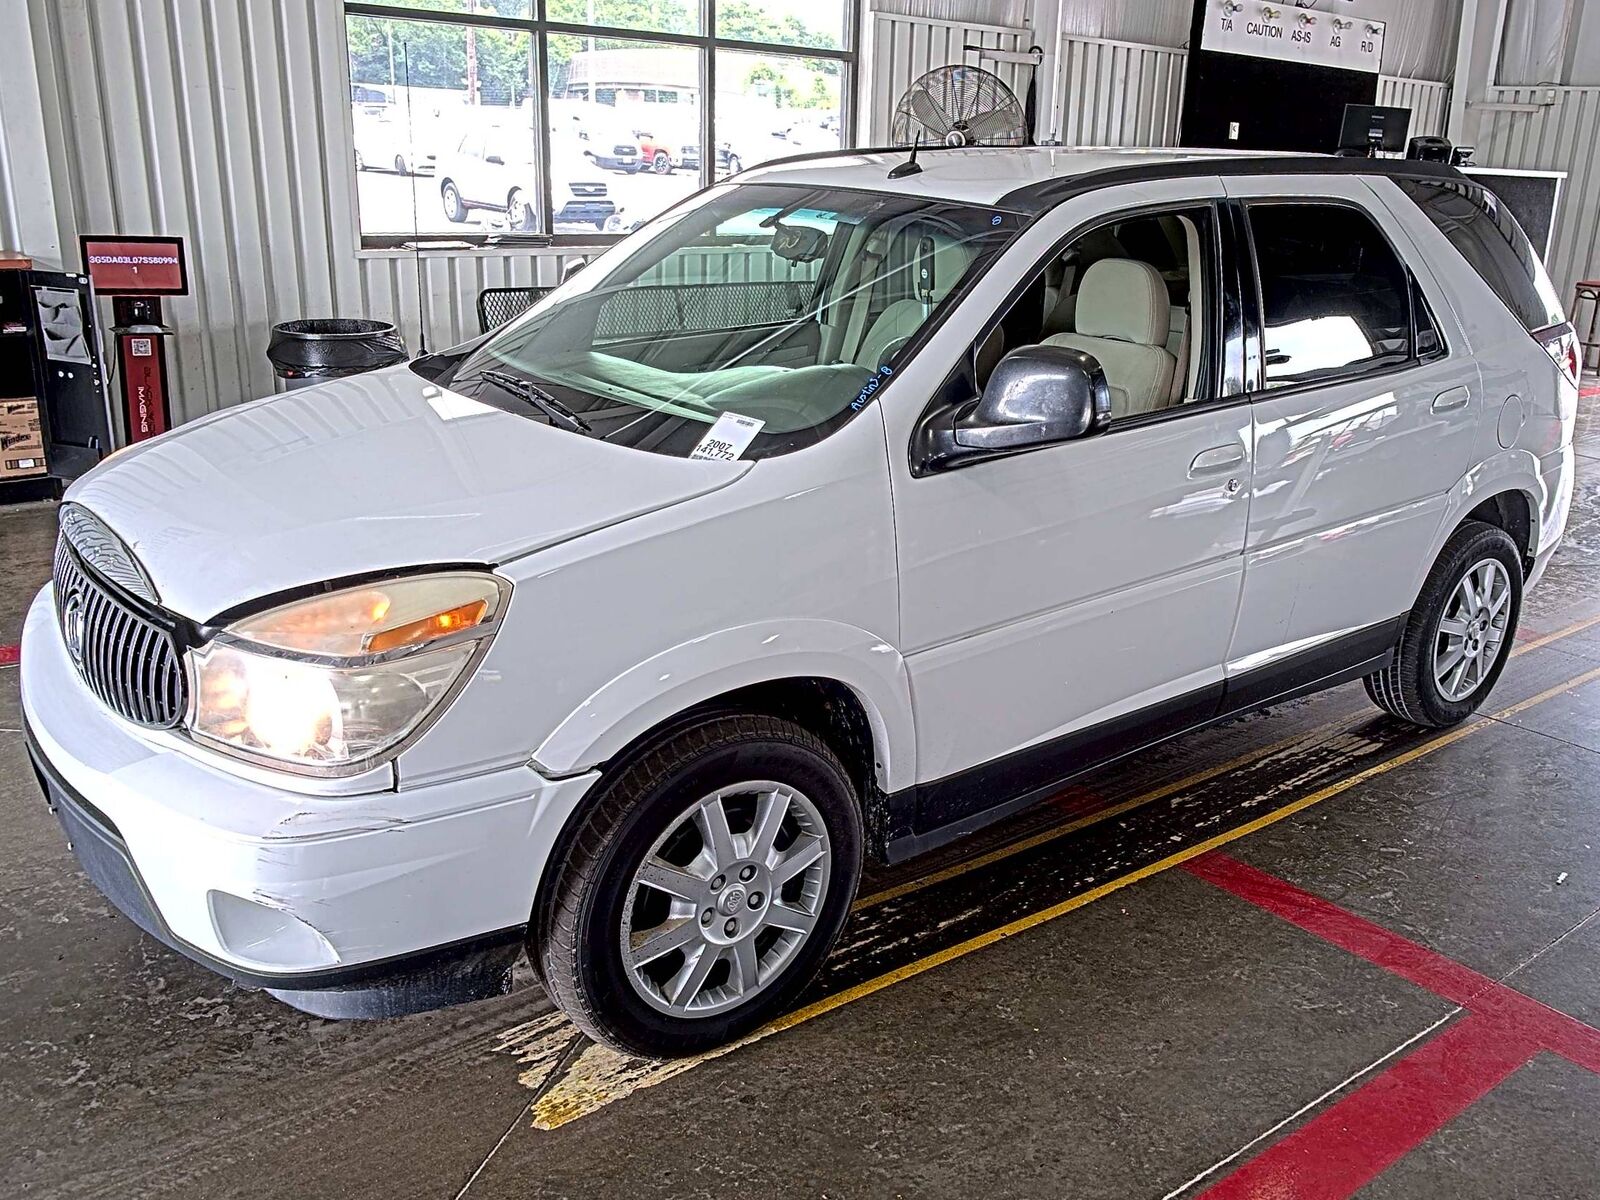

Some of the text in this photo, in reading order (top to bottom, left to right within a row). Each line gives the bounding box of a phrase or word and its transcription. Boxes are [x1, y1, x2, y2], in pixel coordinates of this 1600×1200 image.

[1221, 18, 1233, 32] T/A
[1247, 22, 1283, 39] CAUTION
[1291, 30, 1312, 44] AS-IS
[1330, 36, 1341, 48] AG
[89, 255, 178, 265] 3G5DA03L07S580994
[132, 266, 138, 274] 1
[138, 386, 149, 433] IMAGING
[707, 439, 733, 451] 2007
[696, 444, 735, 461] 141,772
